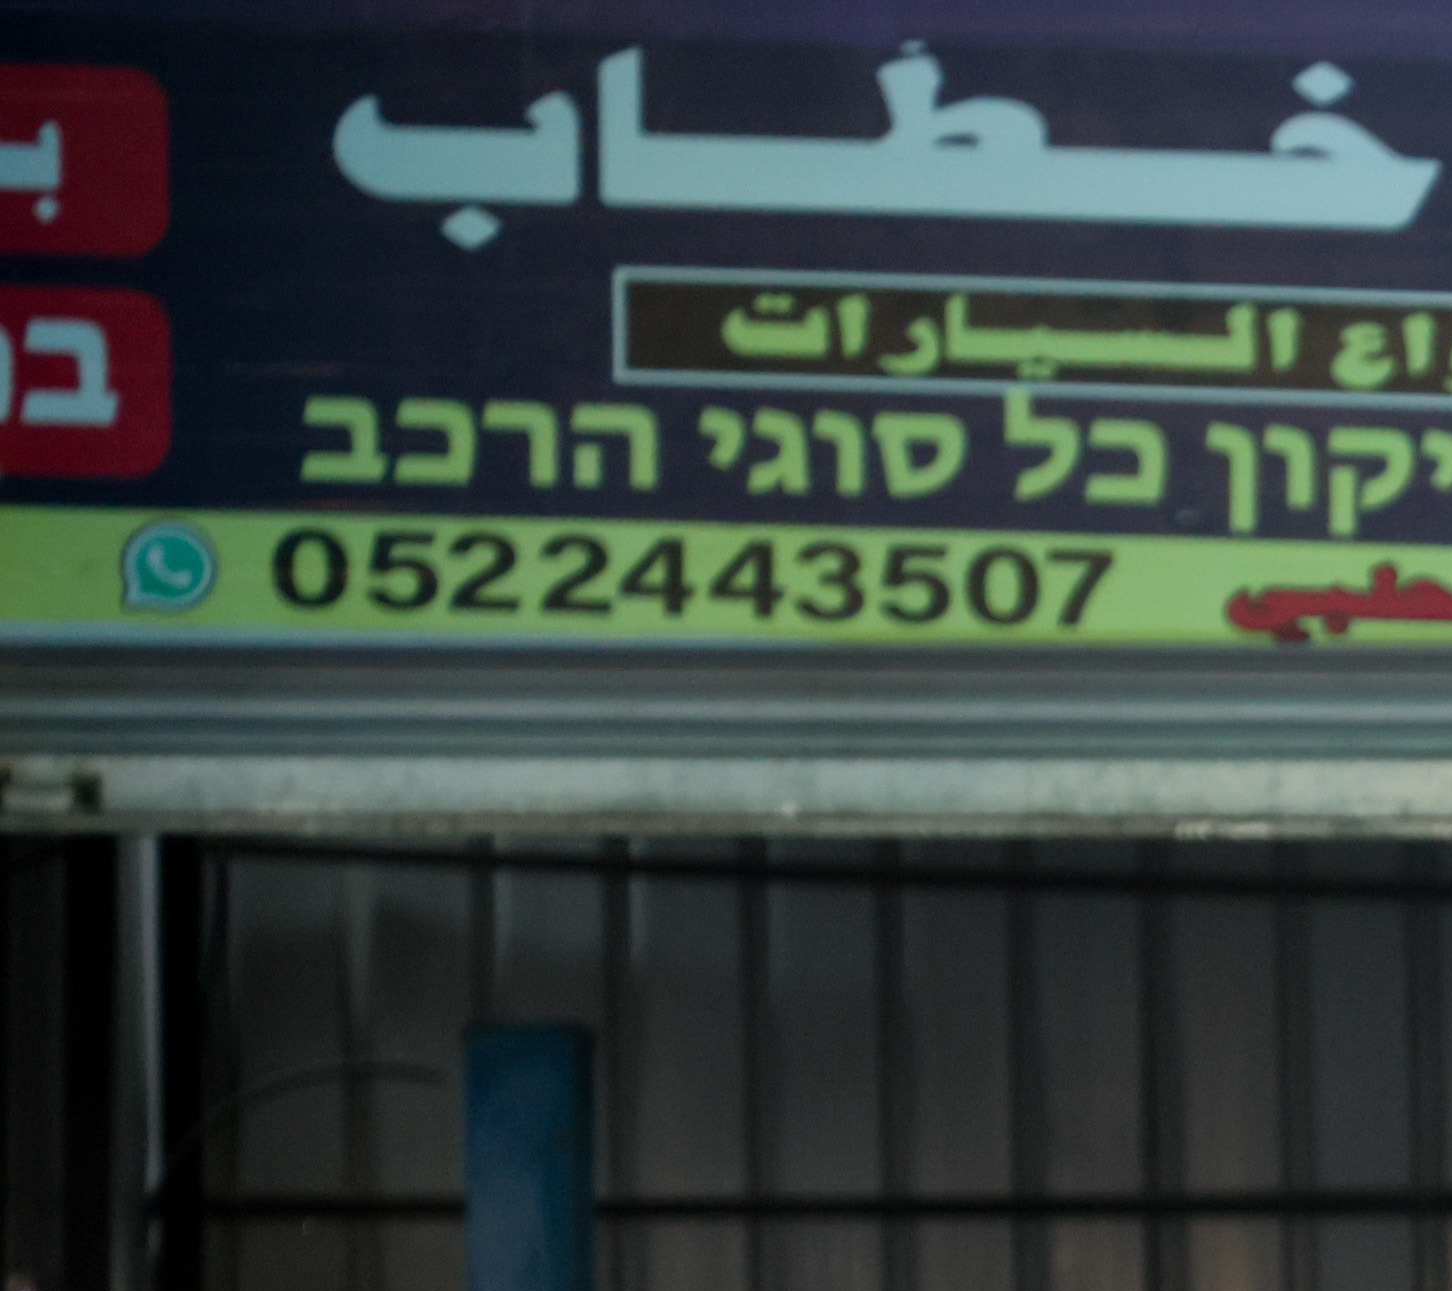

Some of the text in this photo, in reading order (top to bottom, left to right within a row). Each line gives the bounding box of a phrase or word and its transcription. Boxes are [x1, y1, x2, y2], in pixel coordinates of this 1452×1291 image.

[333, 47, 1442, 250] خطاب
[721, 293, 1302, 378] السيارات
[302, 398, 660, 490] הרכב
[700, 406, 968, 497] סוגי
[1004, 386, 1168, 505] כל
[271, 526, 1116, 628] 0522443507
